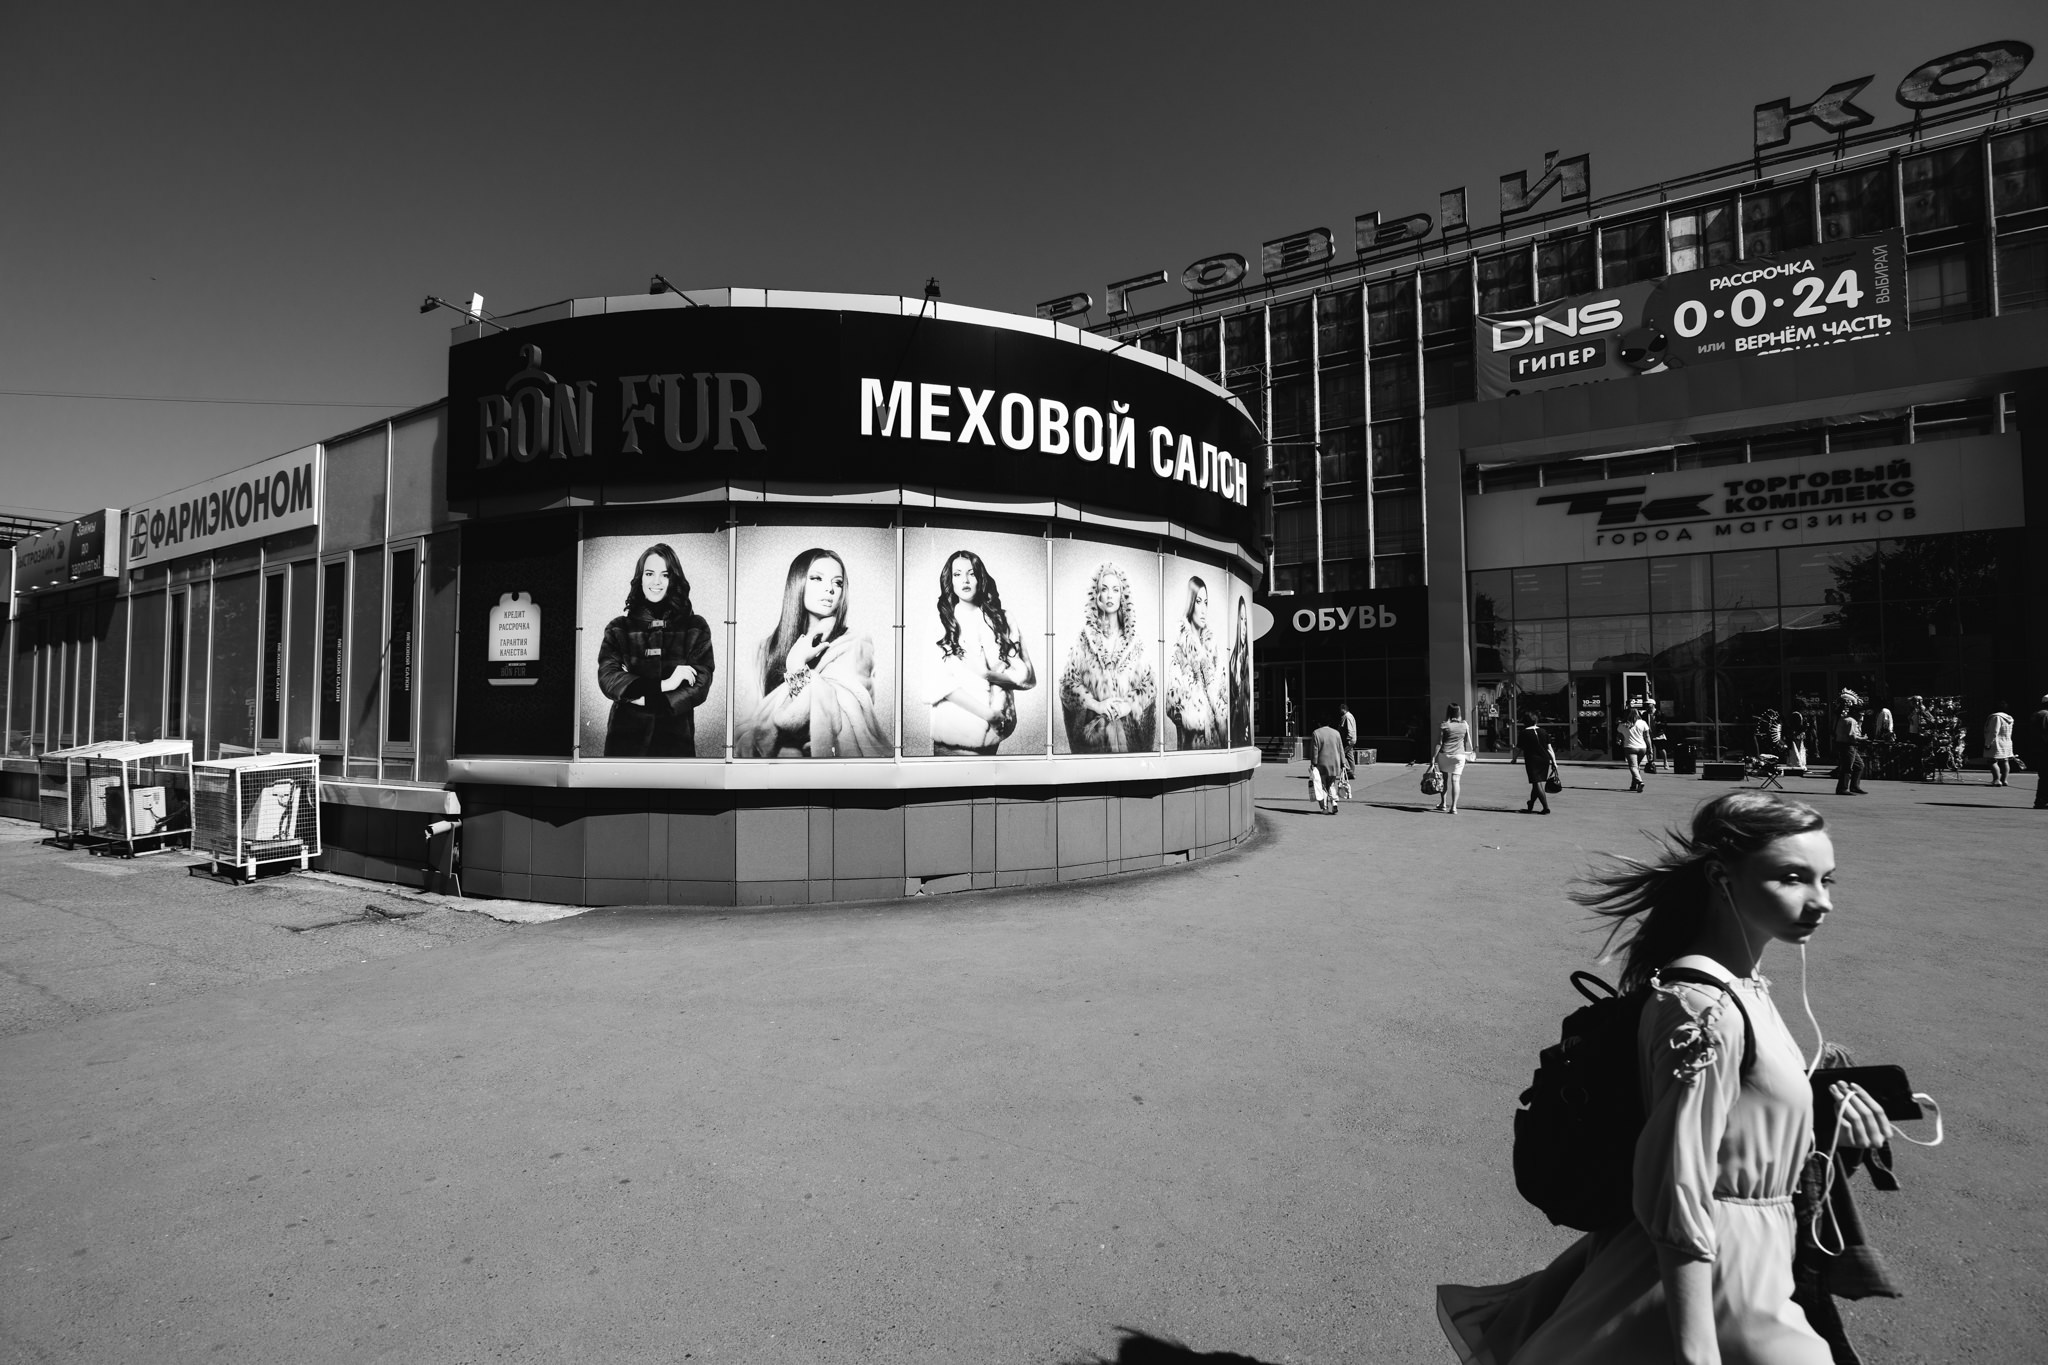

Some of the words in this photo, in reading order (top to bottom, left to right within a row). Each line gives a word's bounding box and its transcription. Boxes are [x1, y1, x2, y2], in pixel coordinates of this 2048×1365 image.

[1709, 259, 1815, 291] РАССРОЧКА
[1872, 244, 1890, 304] ВЫБИРАЙ
[1492, 299, 1623, 352] DNS
[1735, 325, 1816, 353] ВЕРНЁМ
[1823, 313, 1892, 337] ЧАСТЬ
[1518, 346, 1597, 375] ГИПЕР
[476, 380, 597, 470] BON
[618, 372, 767, 455] FUR
[860, 377, 1136, 470] МЕХОВОЙ
[1149, 425, 1248, 507] САЛОН
[1723, 458, 1912, 496] ТОРГОВЫЙ
[149, 463, 313, 549] ФАРМЭКОНОМ
[1724, 481, 1915, 513] КОМПЛЕКС
[498, 622, 530, 631] РАССРОЧКА
[503, 610, 526, 619] КРЕДИТ
[1292, 604, 1397, 633] ОБУВЬ
[499, 648, 527, 657] КАЧЕСТВА
[500, 638, 527, 647] ГАРАНТИЯ
